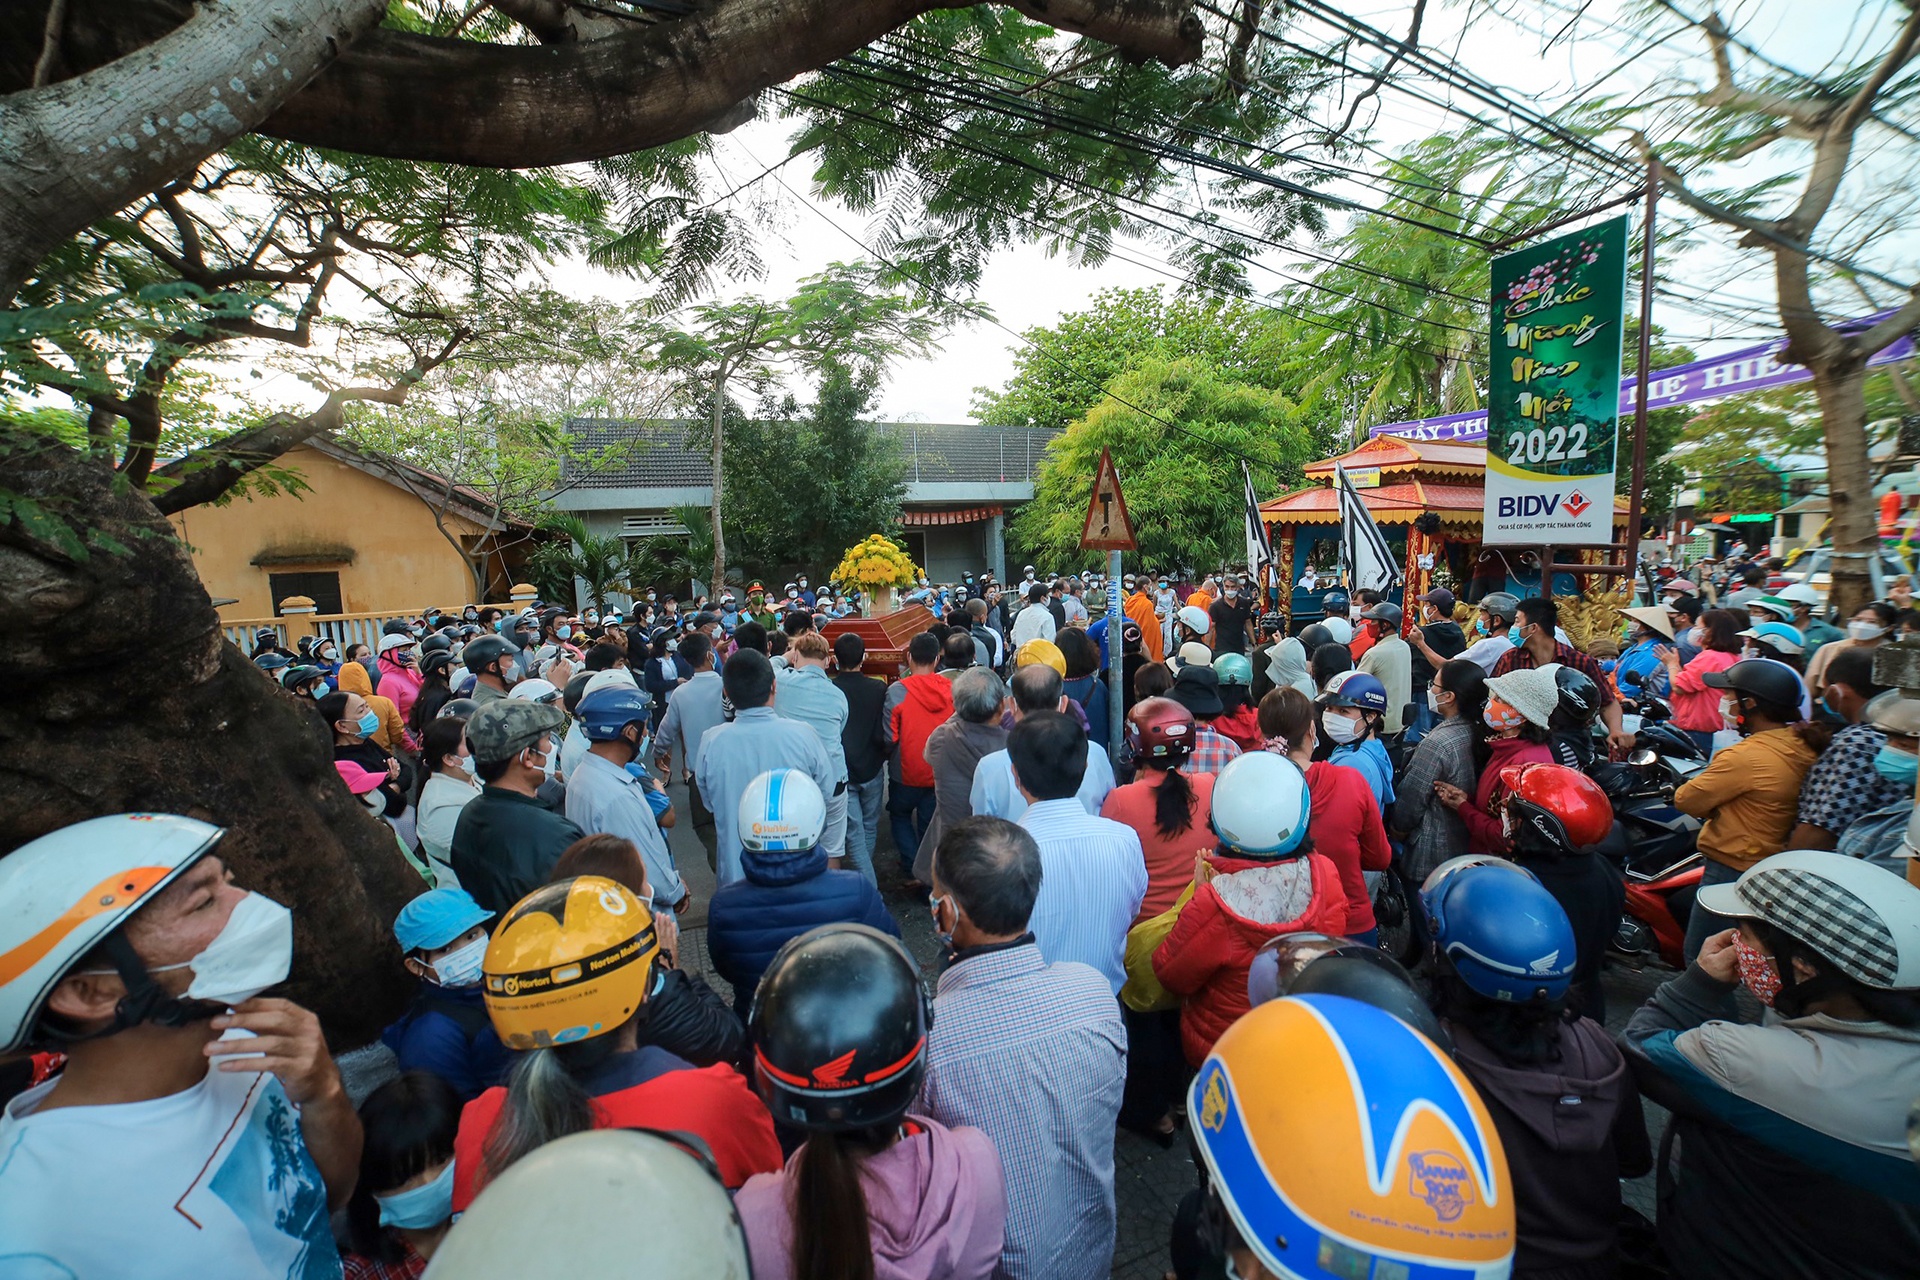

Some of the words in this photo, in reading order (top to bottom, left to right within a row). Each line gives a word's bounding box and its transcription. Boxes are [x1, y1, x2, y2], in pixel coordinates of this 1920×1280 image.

[1505, 282, 1595, 318] Chúc
[1501, 315, 1612, 353] Mừng
[1511, 356, 1579, 385] Năm
[1514, 389, 1572, 424] Mới
[1507, 423, 1588, 465] 2022
[1498, 493, 1560, 517] BIDV
[1576, 521, 1592, 529] CÔNG
[1531, 815, 1560, 845] Vespa
[590, 952, 620, 971] Norton
[620, 941, 641, 958] Mobile
[519, 976, 550, 989] Norton
[813, 1080, 860, 1089] HONDA
